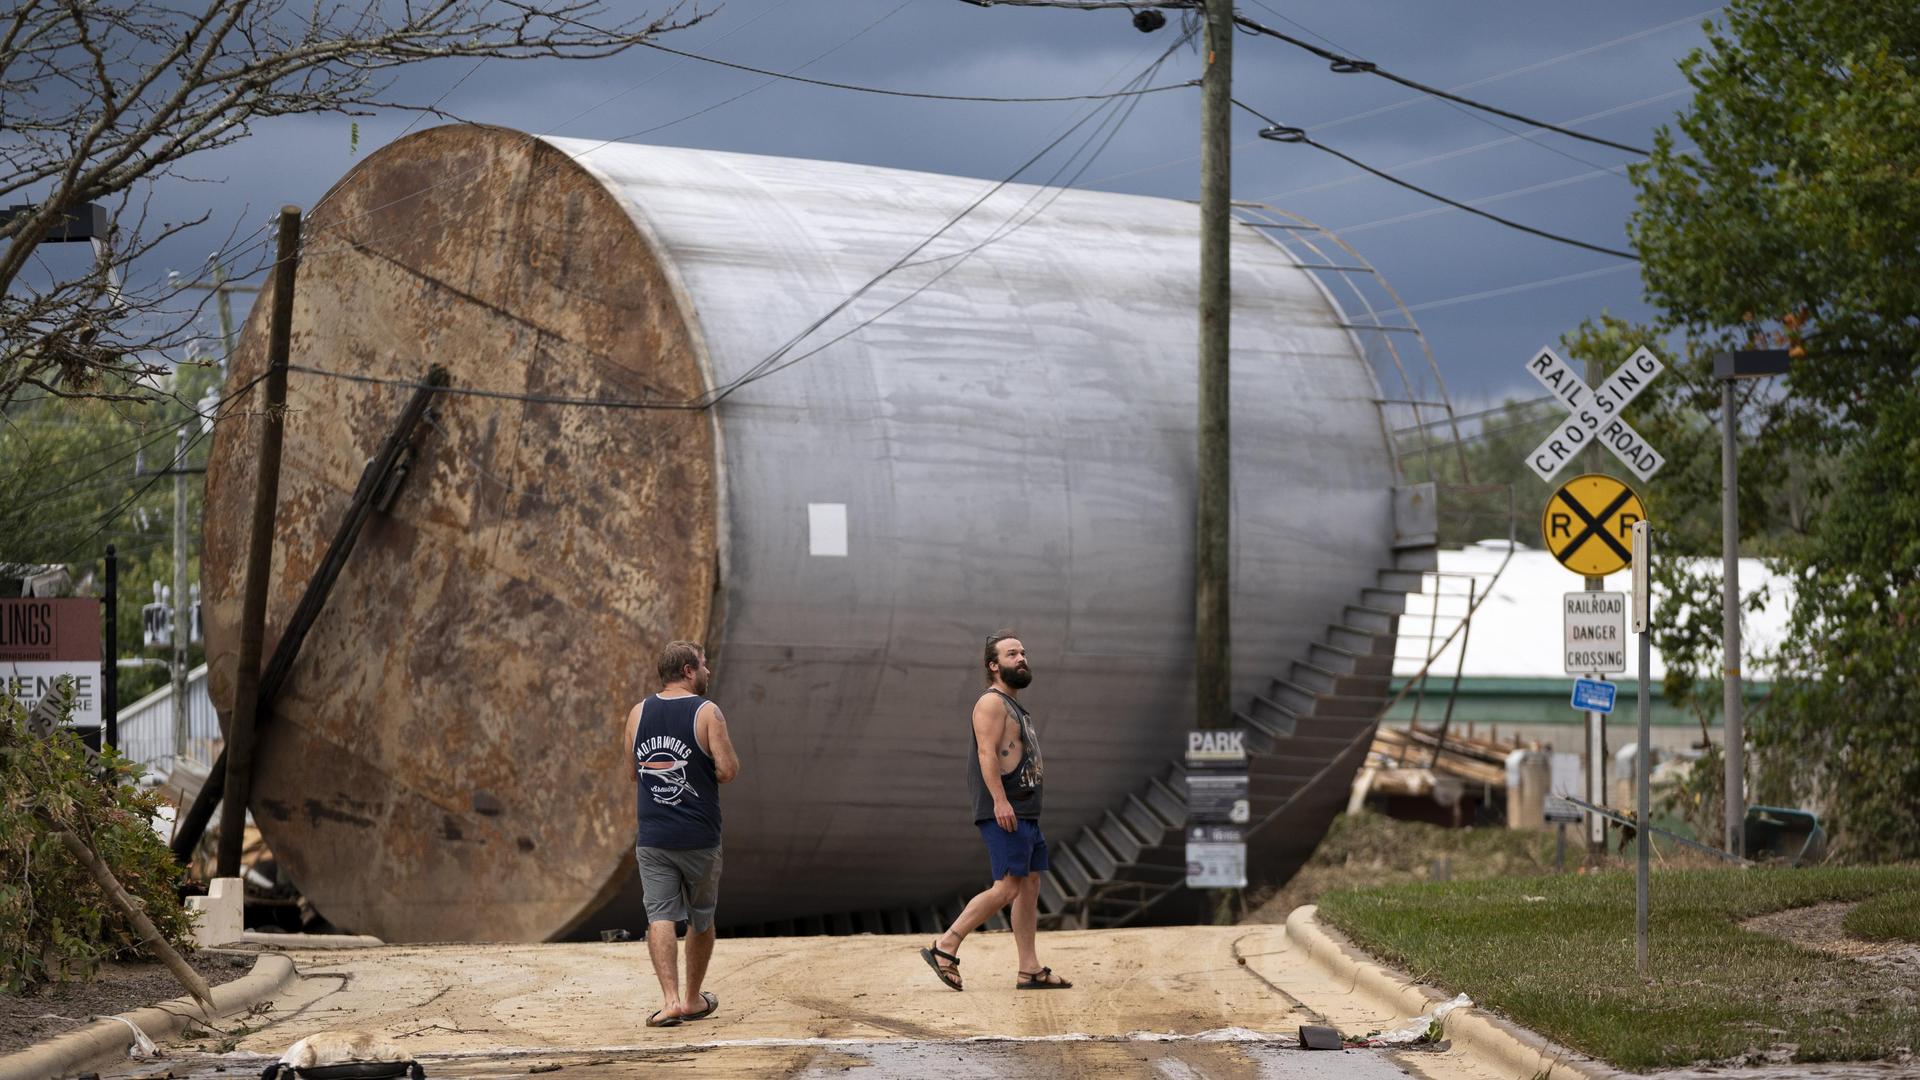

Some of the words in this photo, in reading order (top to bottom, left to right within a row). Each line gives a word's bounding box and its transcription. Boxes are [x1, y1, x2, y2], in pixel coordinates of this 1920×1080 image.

[1533, 353, 1583, 408] RAIL
[1603, 421, 1656, 473] ROAD
[1535, 355, 1655, 473] CROSSING
[1552, 513, 1572, 538] R
[1567, 599, 1622, 614] RAILROAD
[1573, 625, 1616, 640] DANGER
[1567, 651, 1623, 667] CROSSING
[0, 676, 92, 698] IENE
[636, 735, 692, 760] MOTORWORKS
[1188, 731, 1245, 754] PARK
[650, 785, 678, 794] Brewing
